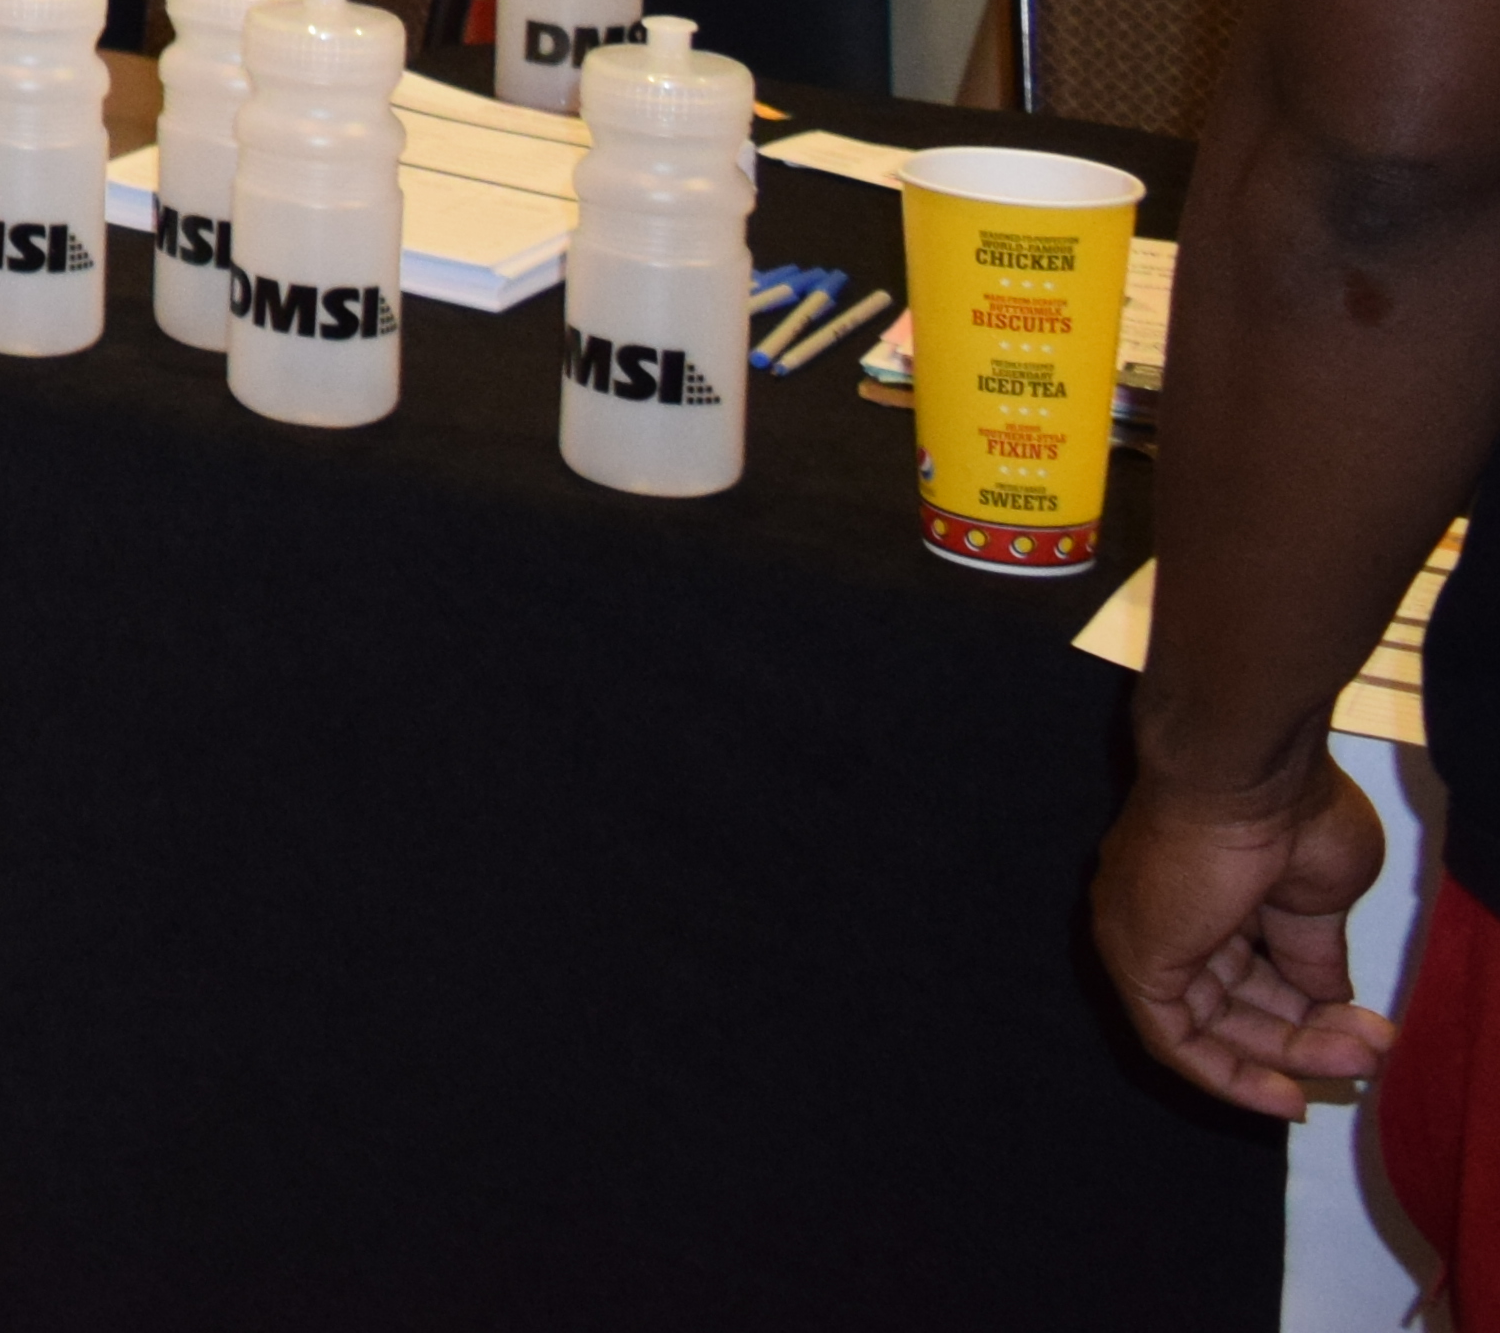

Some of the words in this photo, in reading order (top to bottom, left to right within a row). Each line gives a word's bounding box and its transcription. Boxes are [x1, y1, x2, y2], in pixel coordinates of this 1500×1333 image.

[975, 247, 1075, 272] CHICKEN
[972, 309, 1072, 334] BISCUITS
[564, 323, 686, 406] MSI
[977, 374, 1025, 398] ICED
[1028, 380, 1067, 400] TEA
[987, 437, 1058, 461] FIXIN'S
[979, 489, 1058, 512] SWEETS
